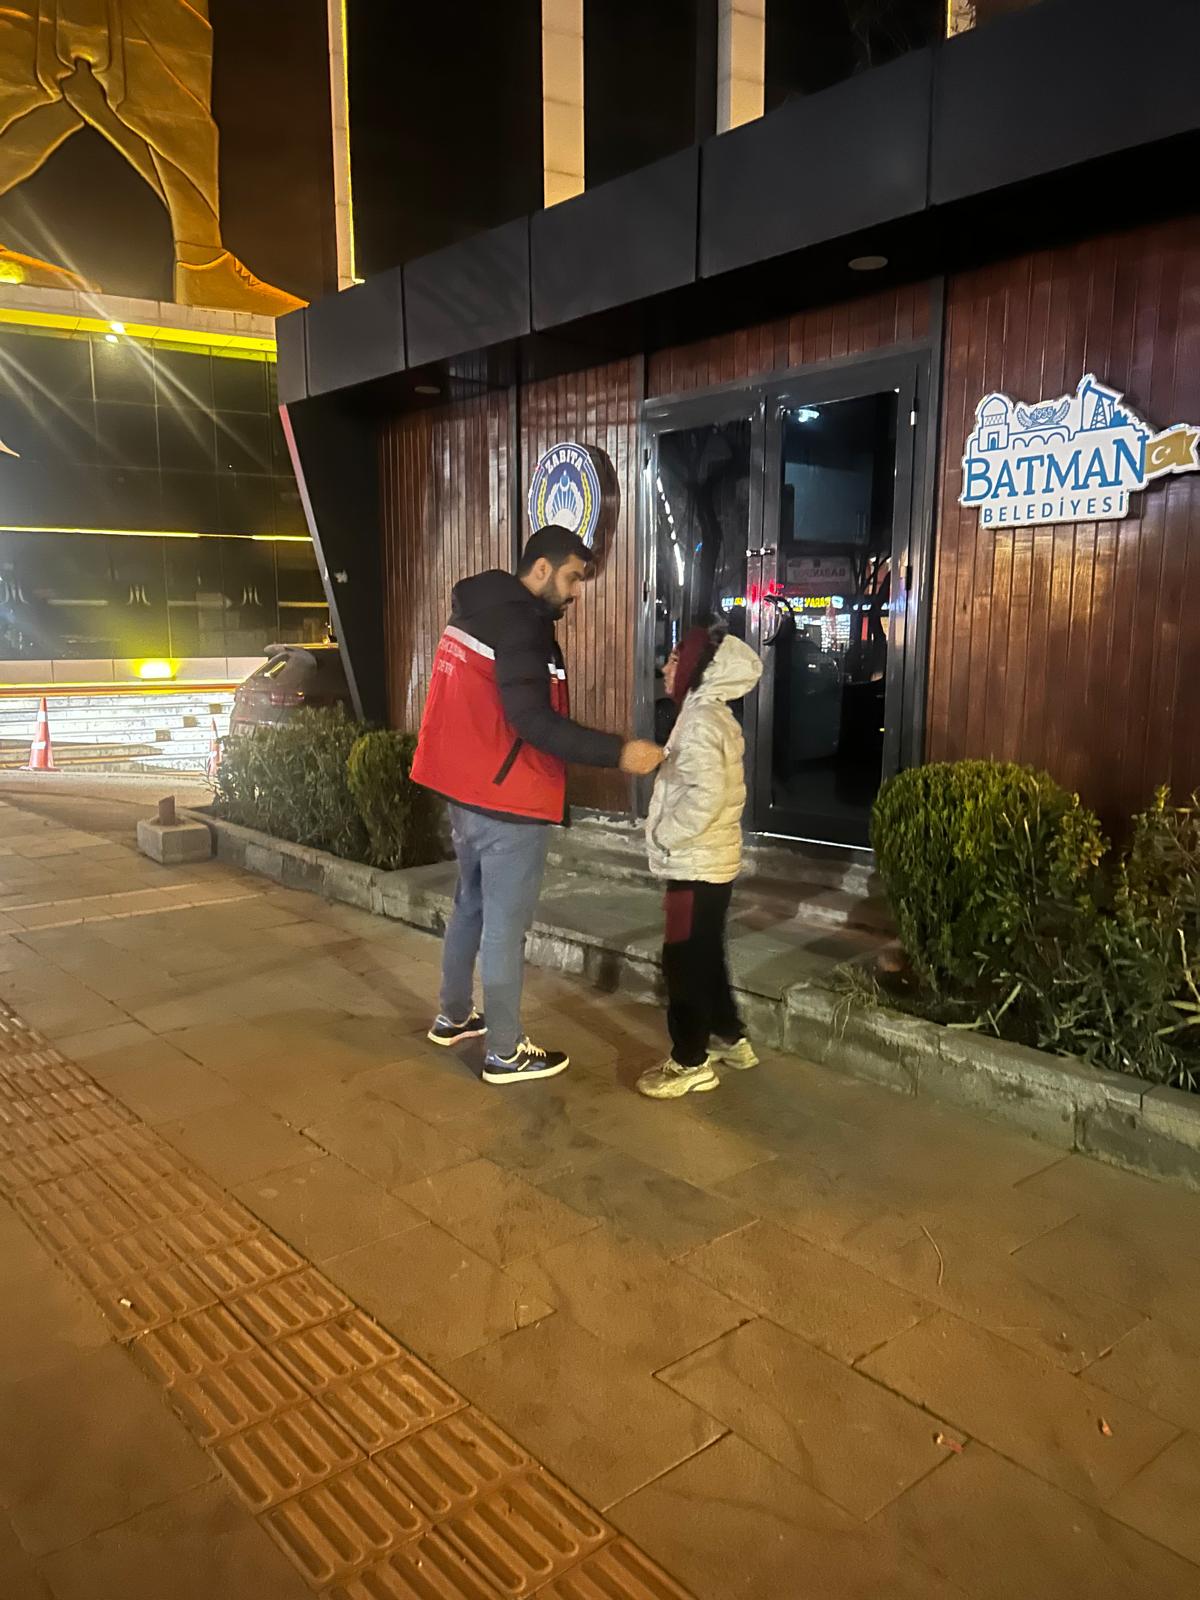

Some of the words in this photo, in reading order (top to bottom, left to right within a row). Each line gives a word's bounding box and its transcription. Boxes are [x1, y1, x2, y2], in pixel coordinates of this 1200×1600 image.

[544, 449, 583, 474] ZABITA
[963, 434, 1149, 502] BATMAN
[983, 490, 1125, 524] BELEDİYESİ
